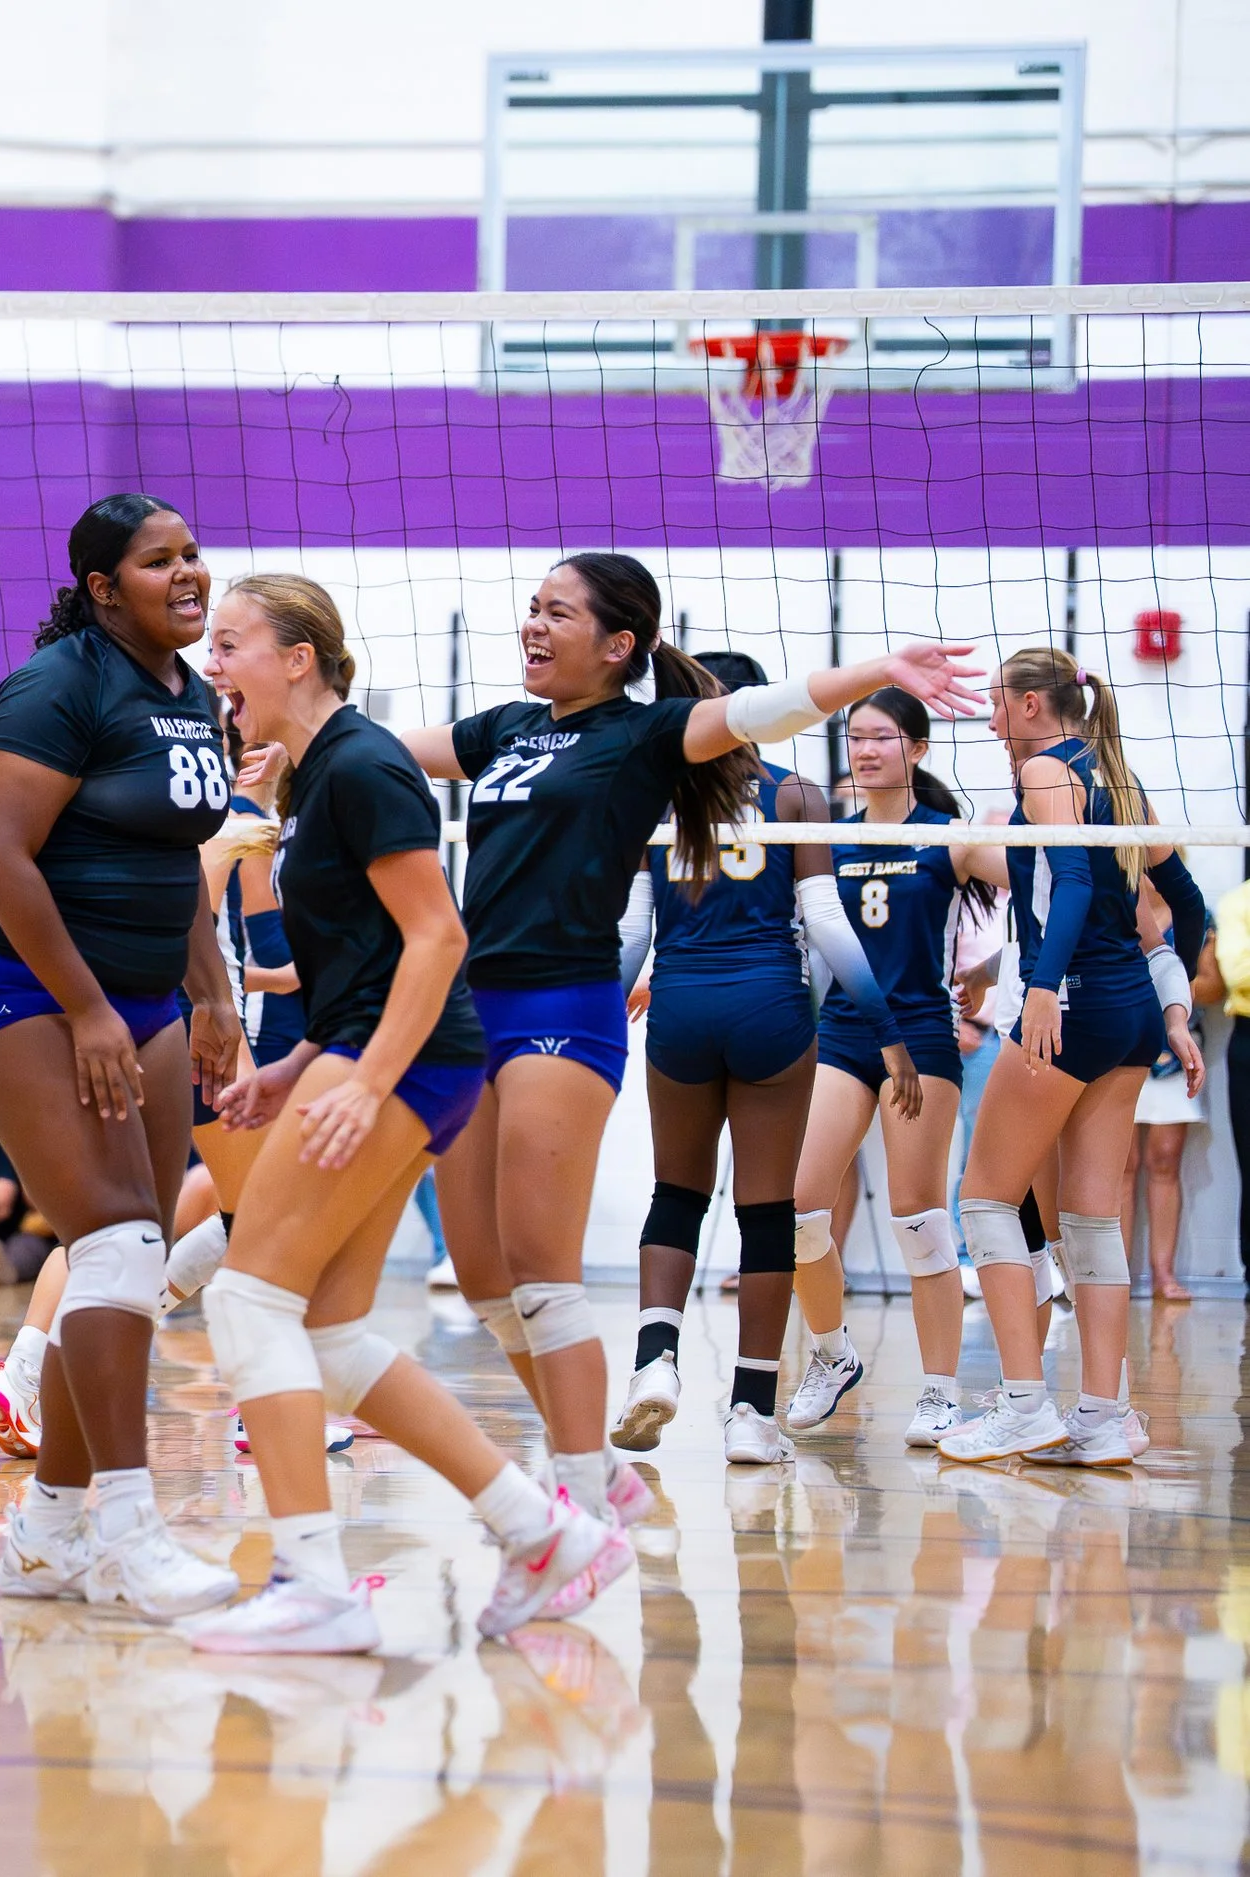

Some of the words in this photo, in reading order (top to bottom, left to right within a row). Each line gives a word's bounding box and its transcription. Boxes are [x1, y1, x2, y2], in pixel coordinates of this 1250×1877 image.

[150, 716, 214, 740] VALENCIA
[510, 733, 581, 752] ENCIA
[169, 744, 228, 810] 88
[472, 752, 555, 803] 22
[861, 879, 890, 928] 8
